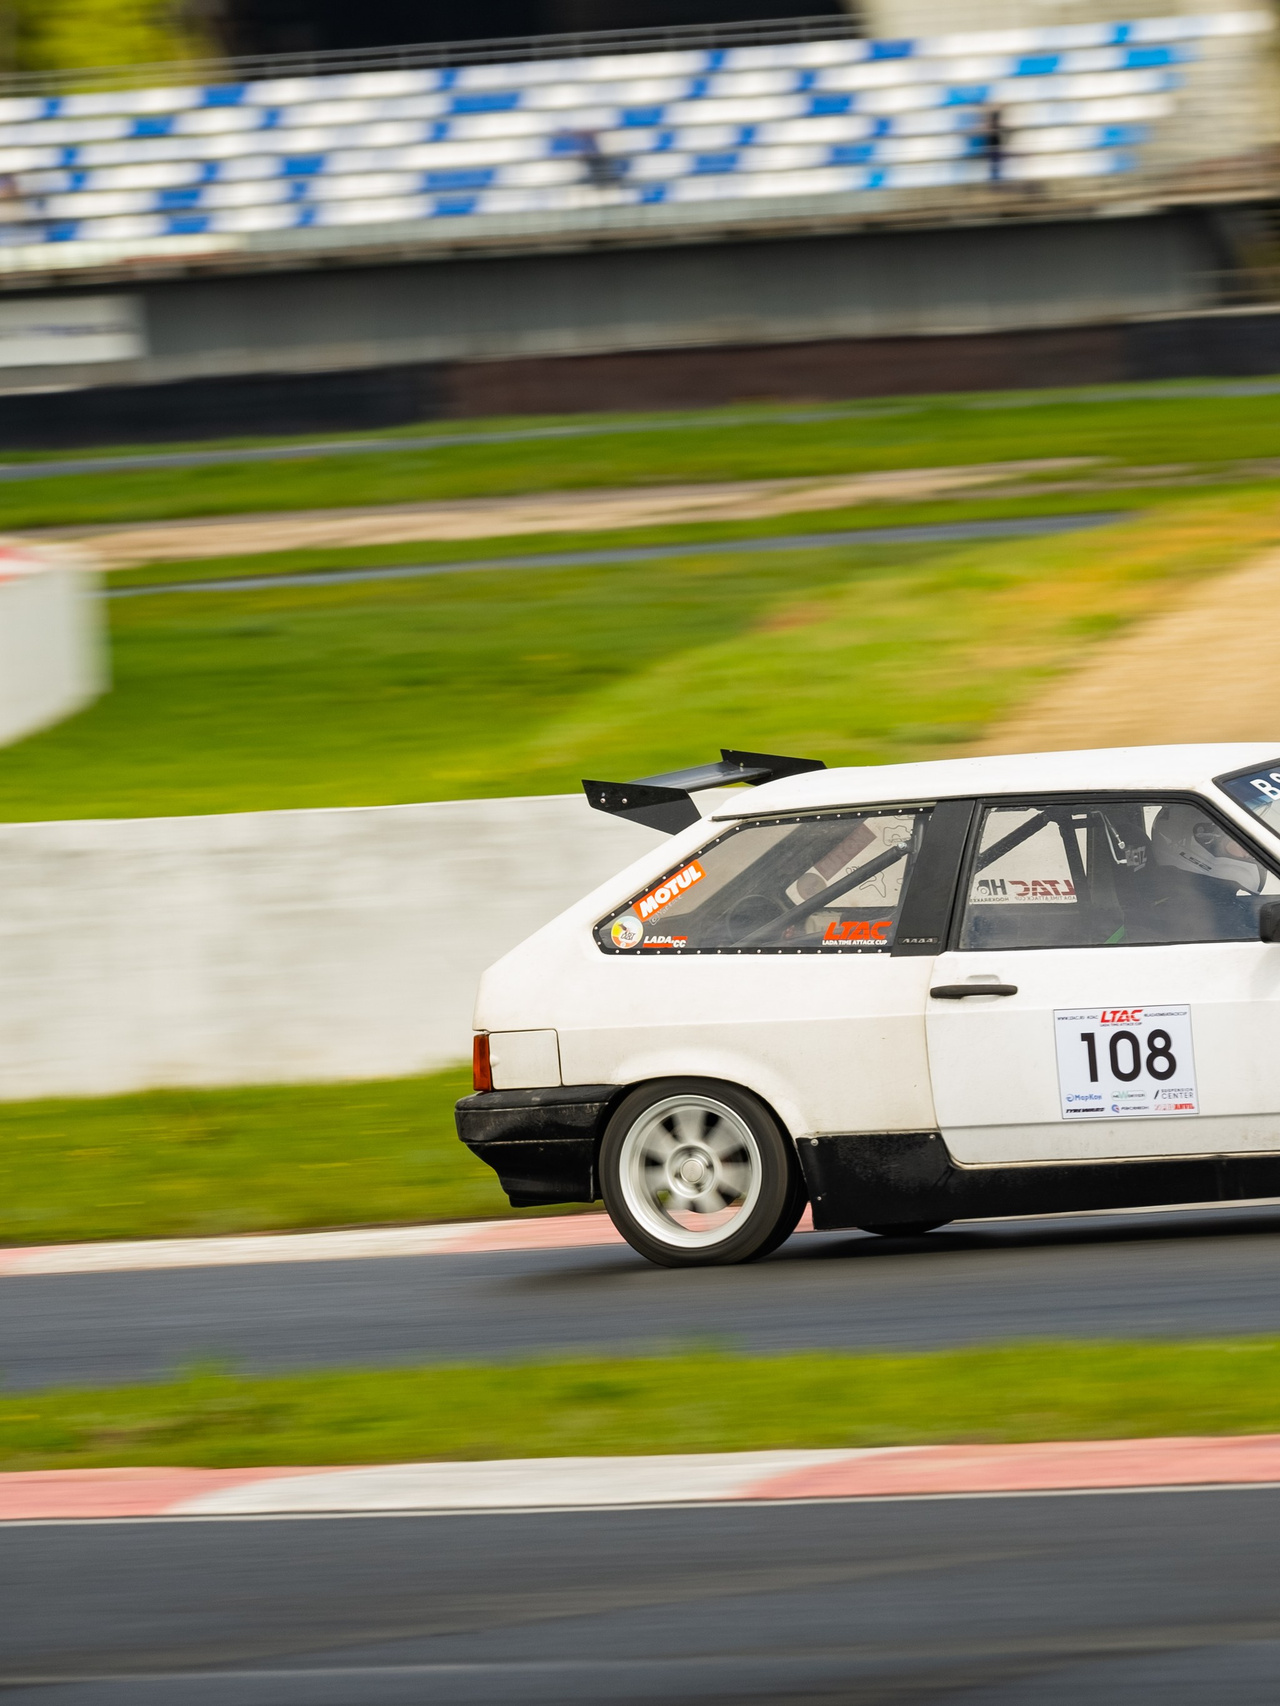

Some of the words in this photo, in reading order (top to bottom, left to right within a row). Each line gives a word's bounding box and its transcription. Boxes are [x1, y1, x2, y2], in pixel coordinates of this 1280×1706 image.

[639, 865, 702, 918] MOTUL
[823, 921, 893, 940] LTAC
[1100, 1009, 1144, 1023] LTAC
[1080, 1028, 1177, 1083] 108
[1161, 1091, 1194, 1100] CENTER
